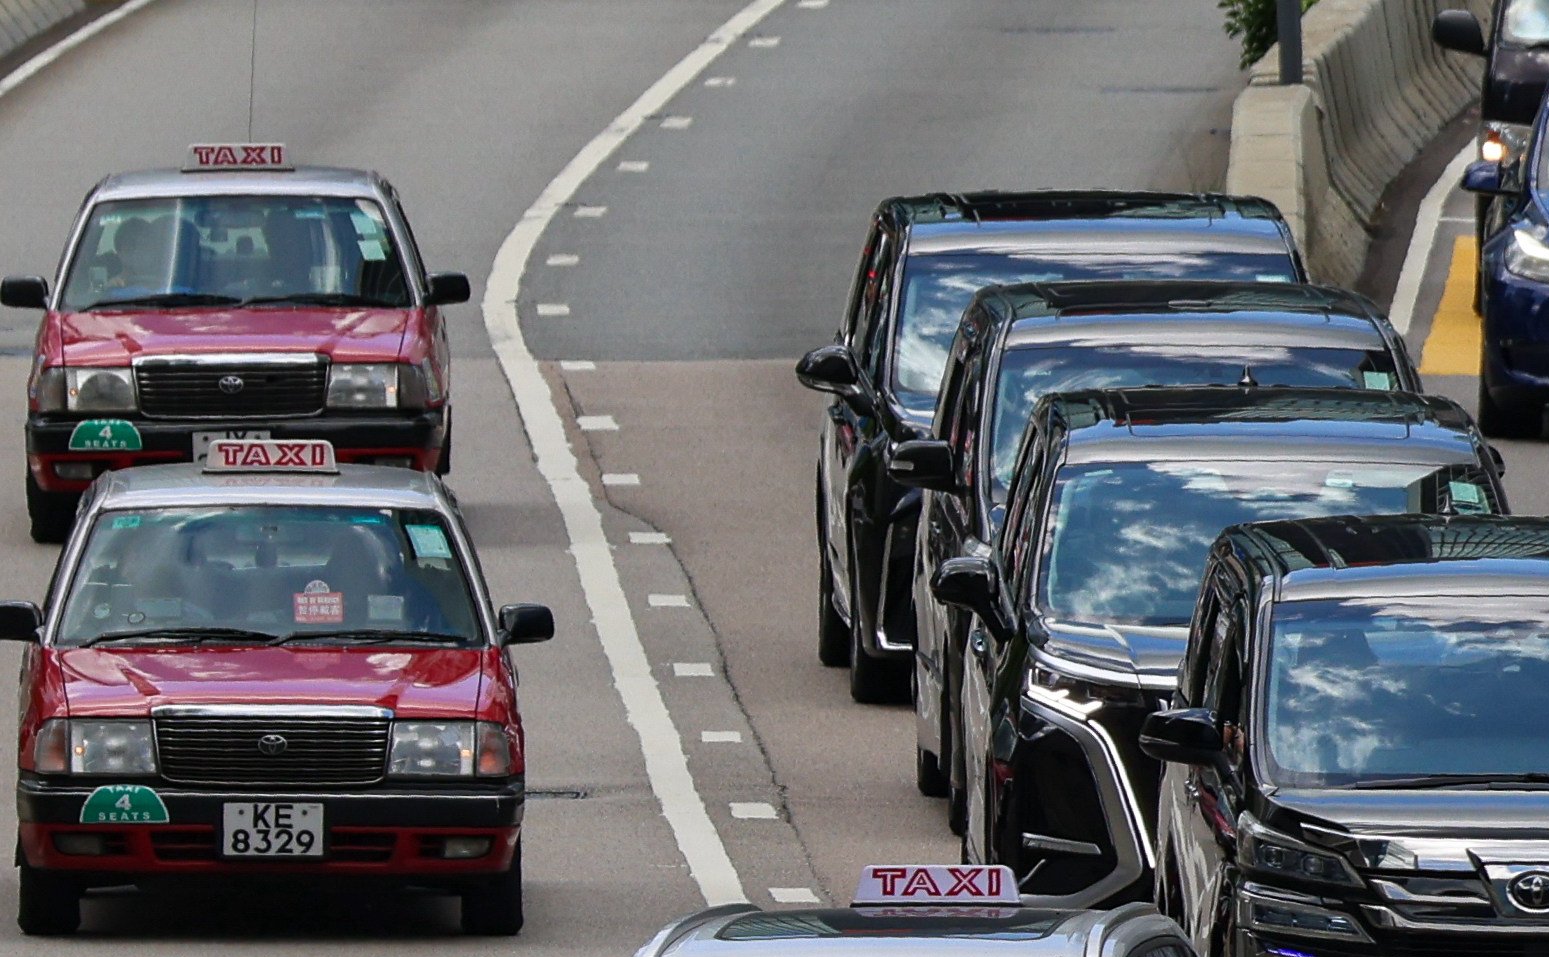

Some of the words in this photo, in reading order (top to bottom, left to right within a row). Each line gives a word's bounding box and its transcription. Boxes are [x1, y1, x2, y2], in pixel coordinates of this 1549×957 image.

[194, 146, 282, 164] TAXI
[99, 425, 112, 439] 4
[218, 444, 324, 465] TAXI
[115, 794, 132, 810] 4
[98, 812, 150, 820] SEATS
[253, 804, 293, 829] KE
[232, 829, 315, 853] 8329
[872, 868, 1001, 896] TAXI
